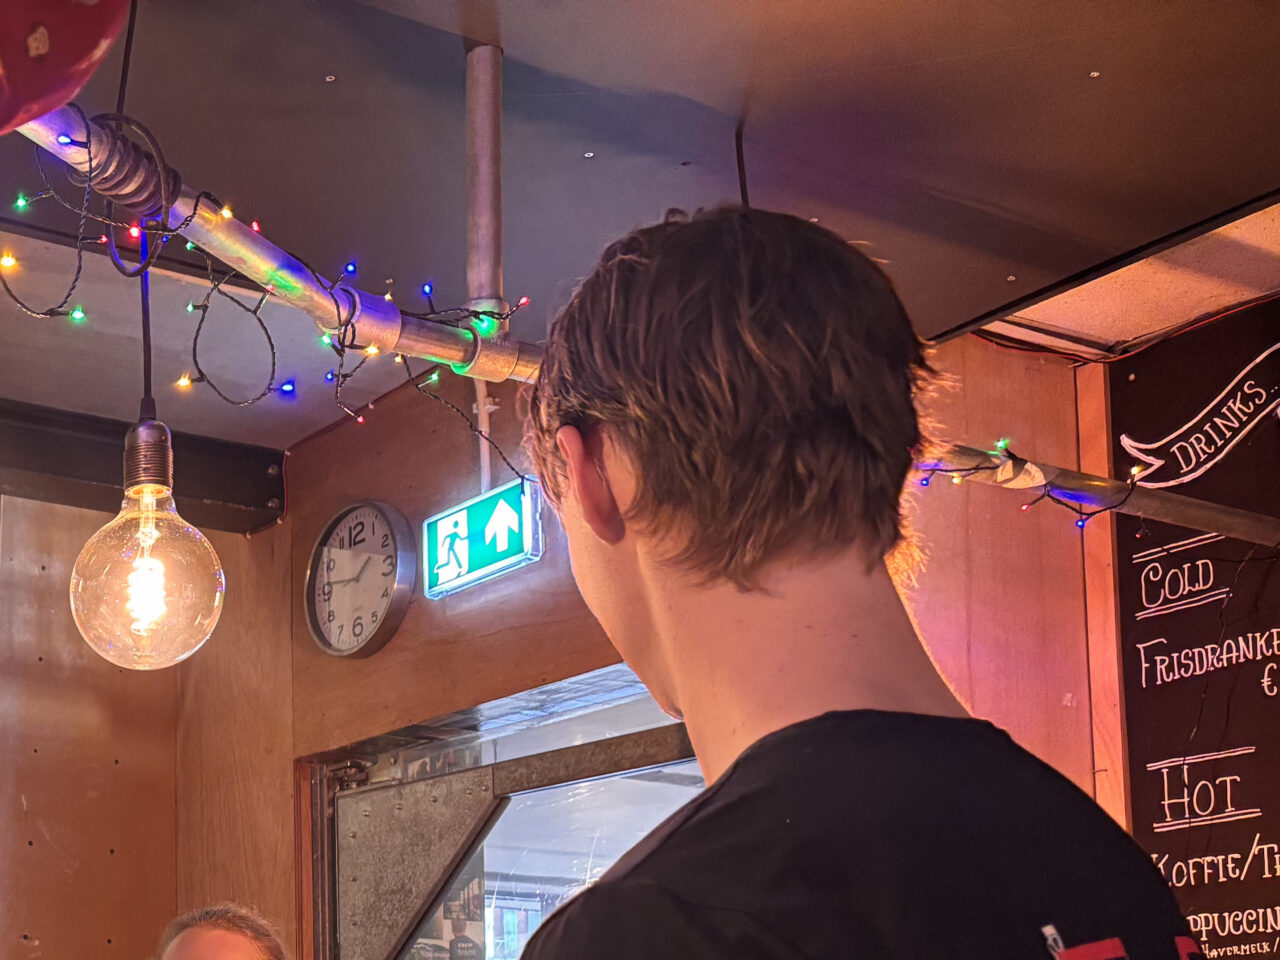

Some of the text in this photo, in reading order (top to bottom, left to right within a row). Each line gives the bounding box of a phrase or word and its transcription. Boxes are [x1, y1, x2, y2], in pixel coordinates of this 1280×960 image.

[348, 521, 366, 548] 12
[372, 522, 376, 536] 1
[339, 535, 345, 549] 11
[381, 534, 389, 548] 2
[326, 558, 336, 573] 10
[382, 555, 395, 577] 3
[322, 581, 333, 601] 9
[1141, 559, 1214, 608] COLD
[381, 586, 389, 598] 4
[328, 611, 336, 623] 8
[371, 612, 379, 623] 5
[337, 625, 344, 642] 7
[352, 617, 364, 637] 6
[1162, 765, 1240, 821] HOT
